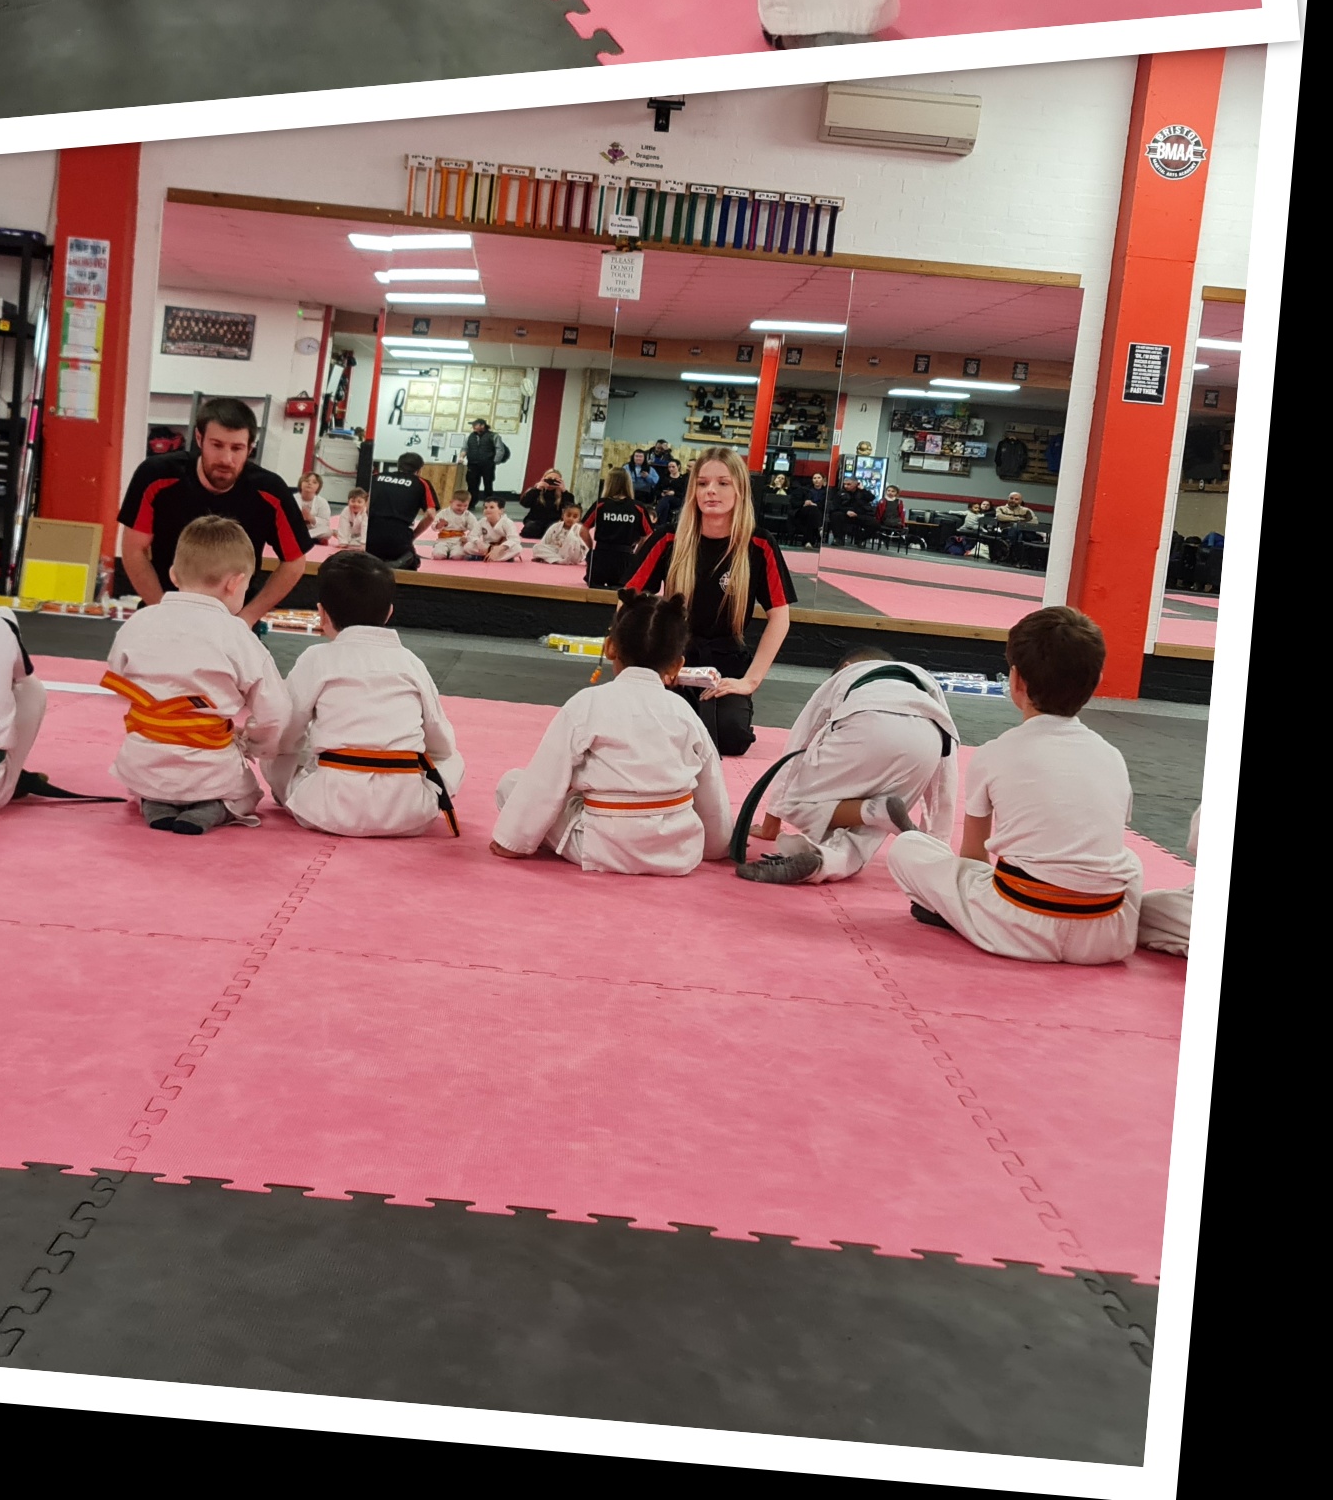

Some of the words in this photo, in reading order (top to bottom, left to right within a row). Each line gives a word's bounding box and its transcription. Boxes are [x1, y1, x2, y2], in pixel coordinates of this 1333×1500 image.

[1156, 126, 1199, 145] BRISTOL
[635, 152, 660, 161] Dragons
[1156, 142, 1194, 161] BMAA
[630, 160, 664, 170] Programme
